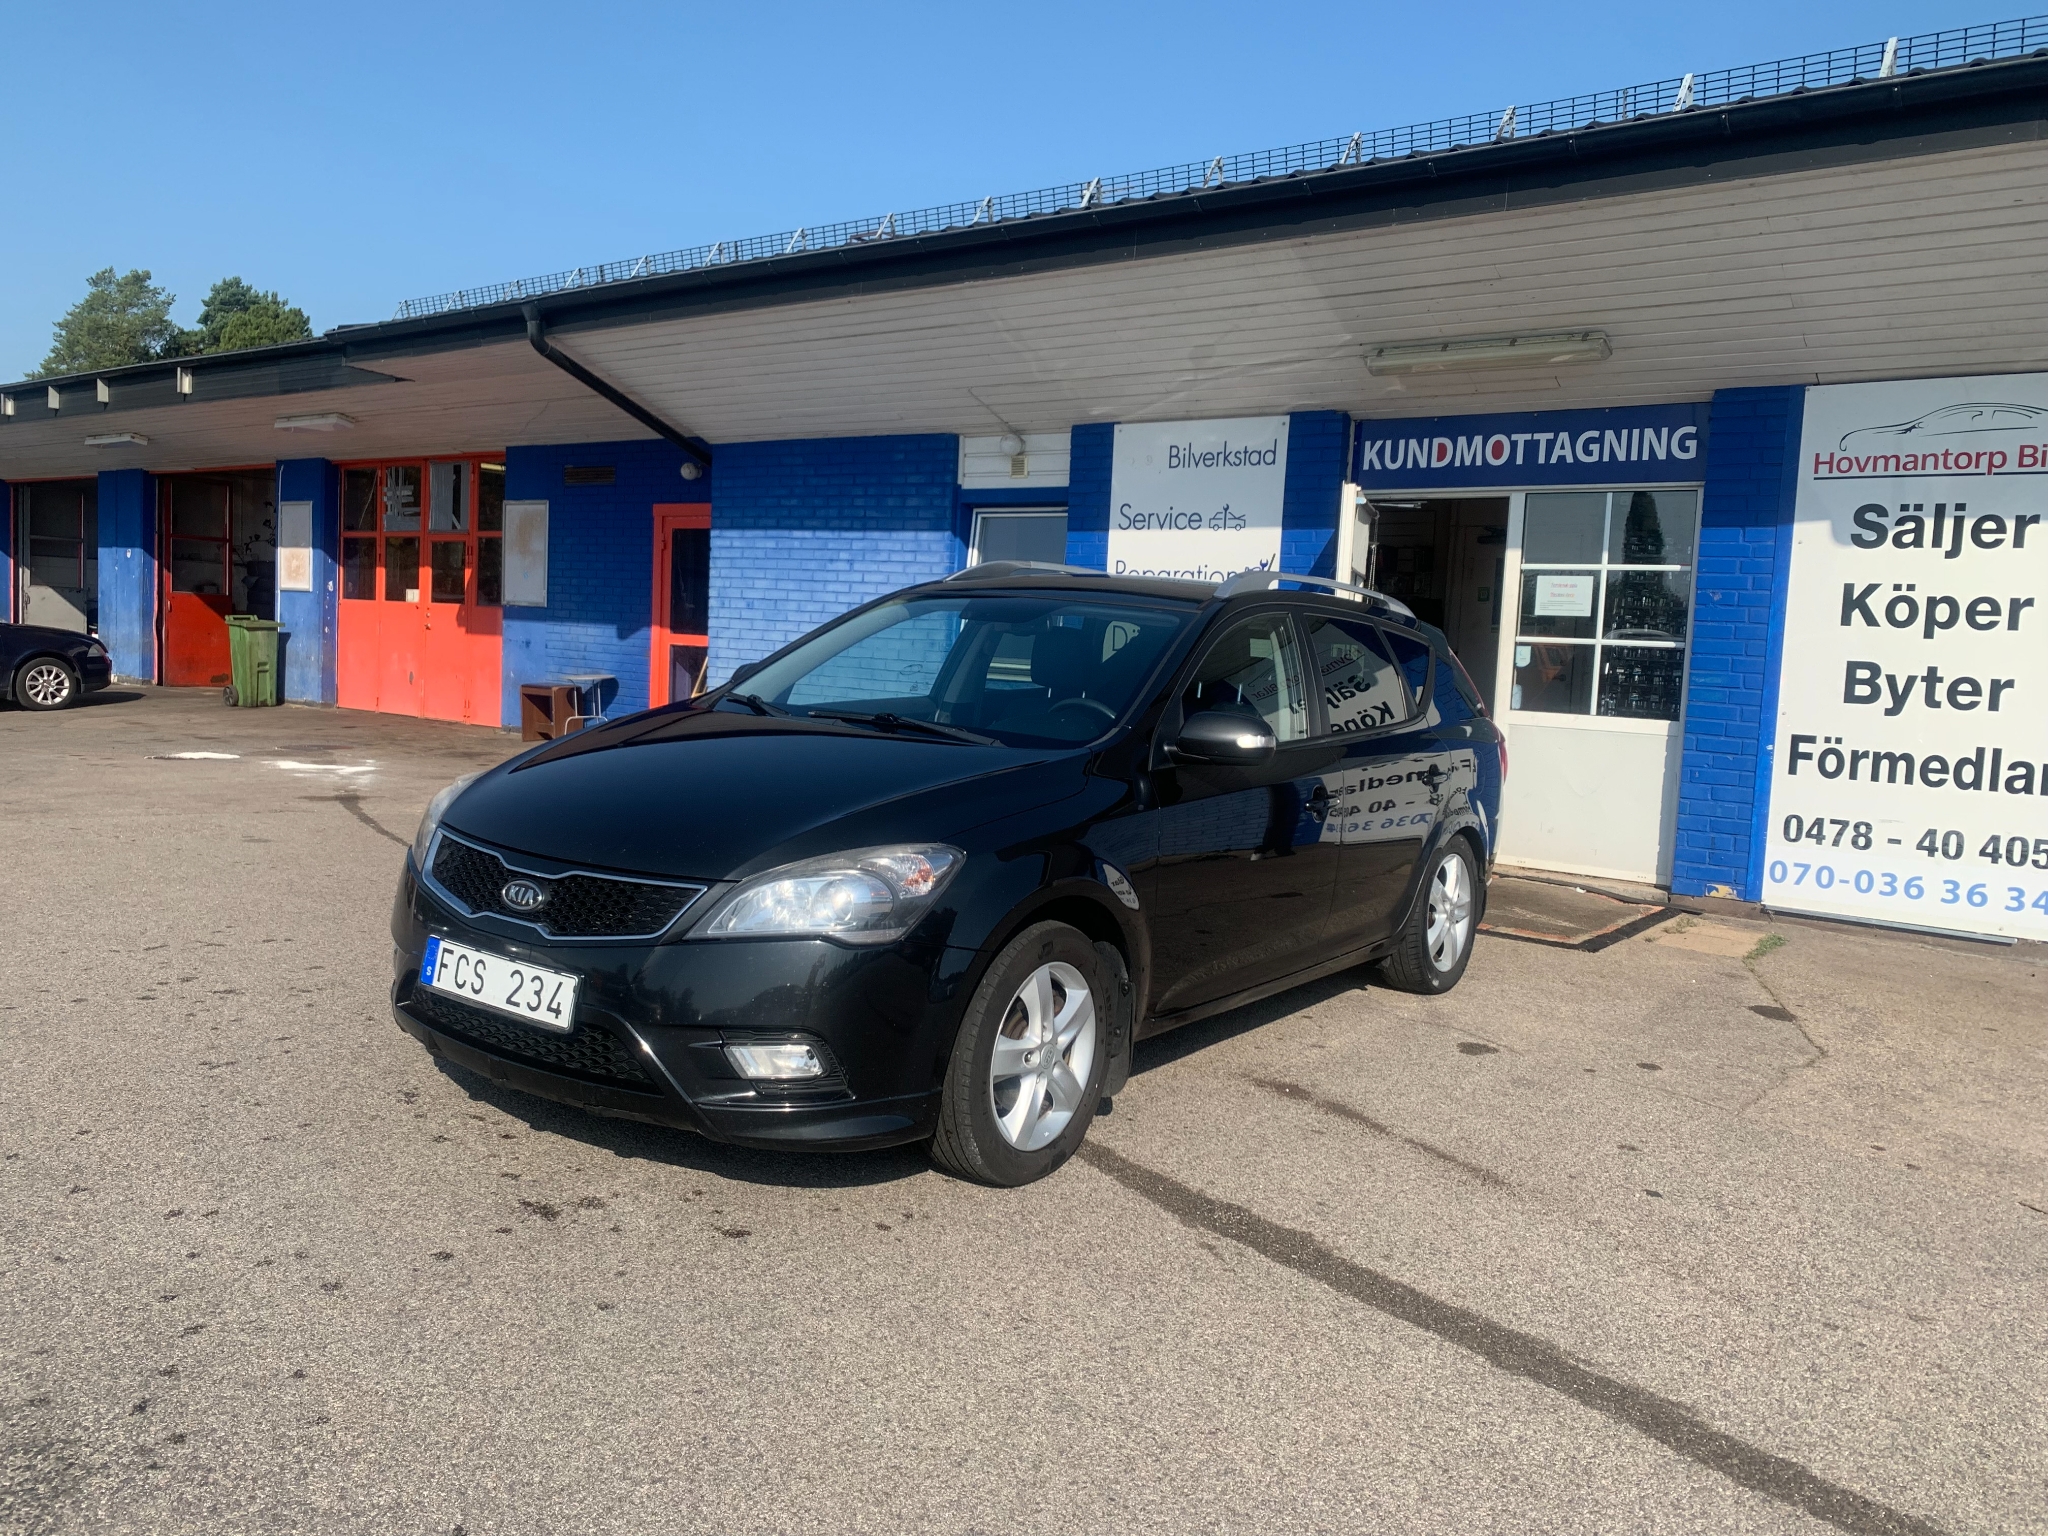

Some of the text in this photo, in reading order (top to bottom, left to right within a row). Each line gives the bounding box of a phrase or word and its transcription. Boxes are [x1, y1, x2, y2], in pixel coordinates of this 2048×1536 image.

[1168, 438, 1278, 469] Bilverkstad
[1362, 425, 1698, 471] KUNDMOTTAGNING
[1813, 448, 2008, 476] Hovmantorp
[1118, 502, 1203, 531] Service
[1850, 502, 2041, 560] Säljer
[1840, 582, 2035, 640] Köper
[1843, 659, 2015, 717] Byter
[1783, 814, 1873, 851] 0478
[1915, 828, 1965, 861] 40
[1978, 834, 2048, 870] 405
[508, 884, 534, 906] KIA
[1768, 860, 2048, 916] 070-036 36 34
[425, 965, 433, 976] S
[437, 947, 564, 1019] FCS 234
